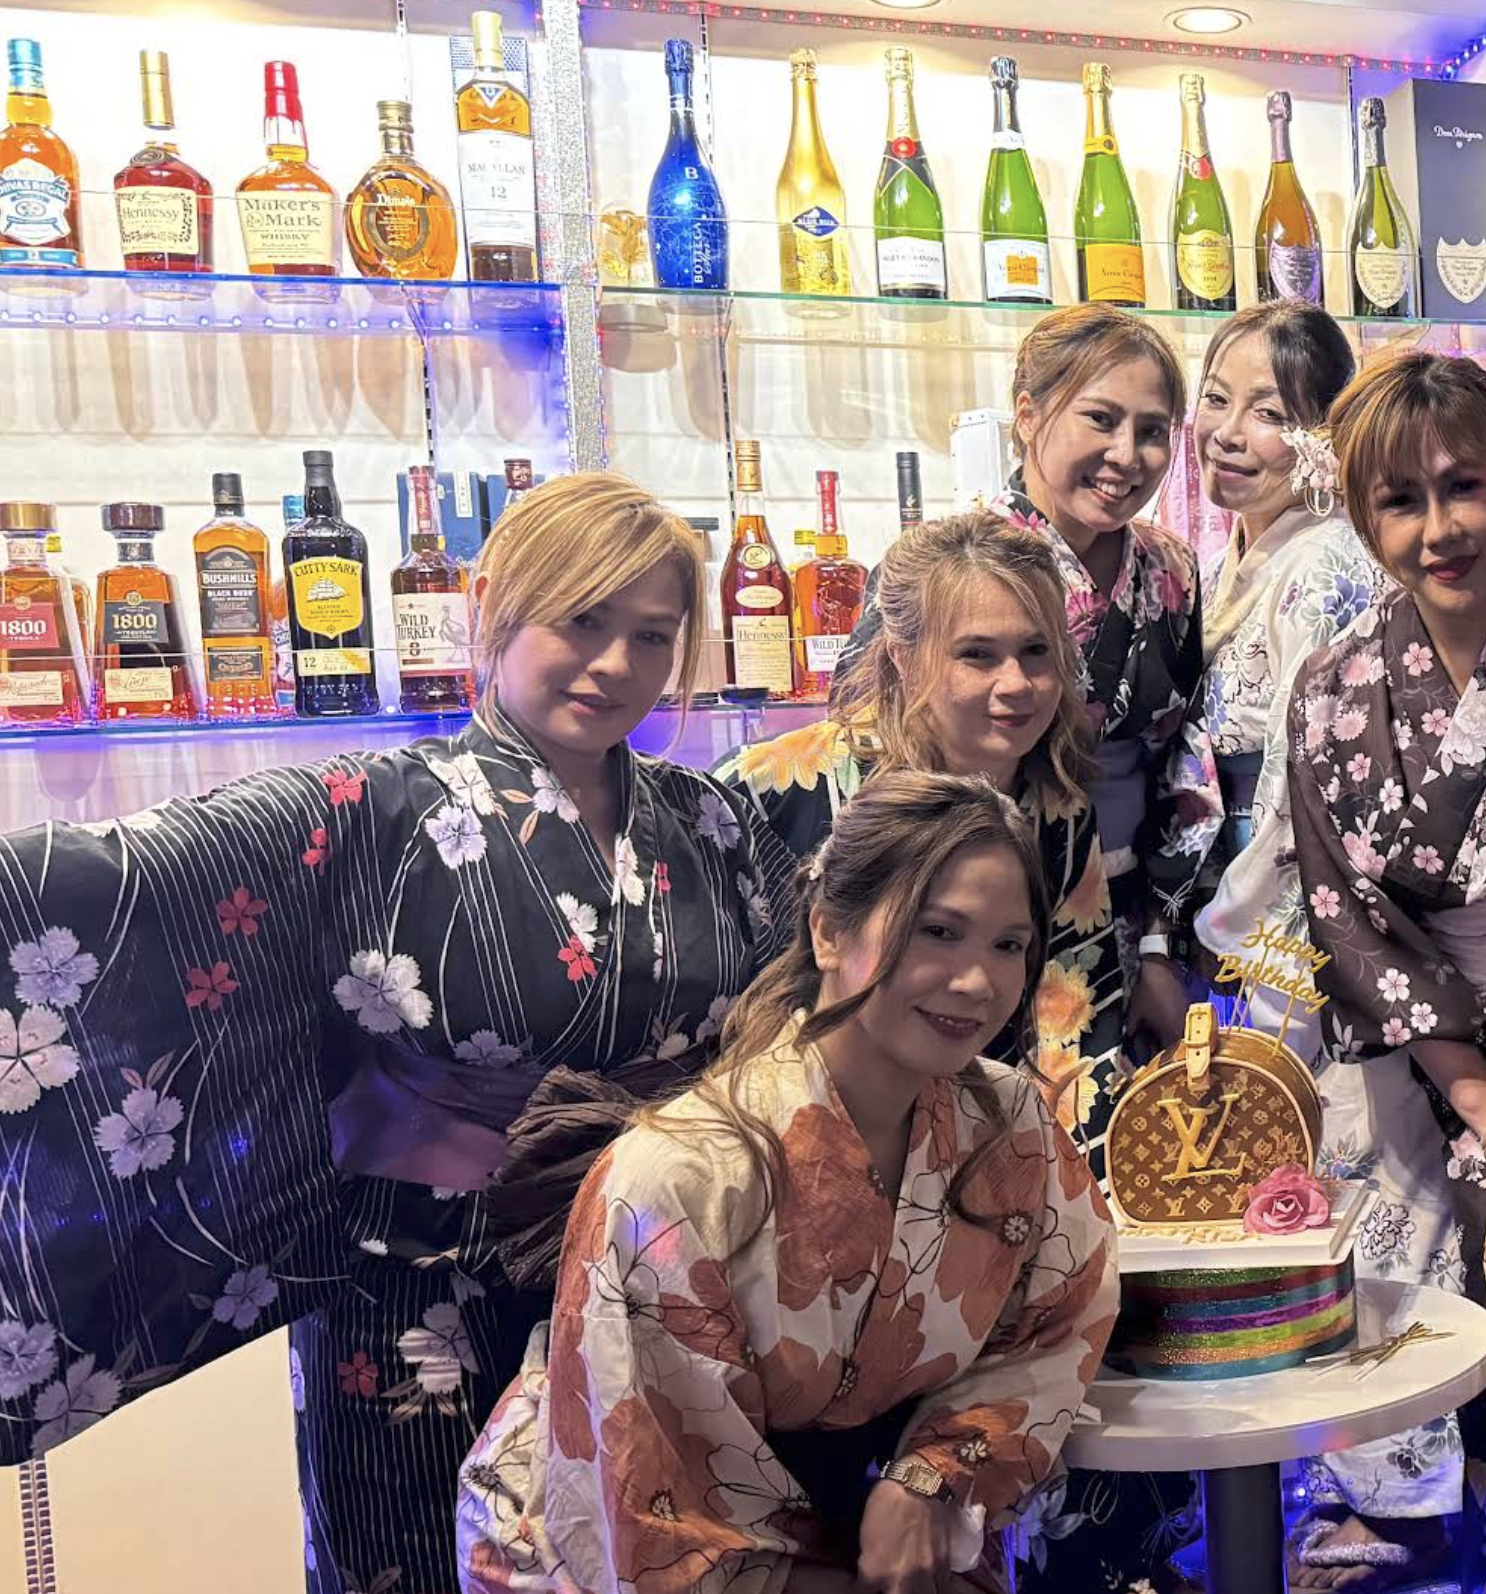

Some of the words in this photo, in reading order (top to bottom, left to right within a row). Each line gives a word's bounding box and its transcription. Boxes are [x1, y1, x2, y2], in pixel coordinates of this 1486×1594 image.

[244, 198, 321, 211] Maker's
[122, 207, 179, 222] Hennessy
[265, 213, 323, 226] Mark
[294, 562, 328, 577] CUTTY
[329, 562, 359, 577] SARK
[202, 573, 257, 585] BUSHMILLS
[0, 620, 47, 635] 1800
[112, 613, 158, 630] 1800
[399, 613, 428, 627] WILD
[396, 625, 437, 640] TURKEY
[409, 642, 421, 657] 8
[303, 657, 317, 668] 12
[1239, 917, 1332, 973] Happy
[1214, 952, 1331, 1014] Birthday
